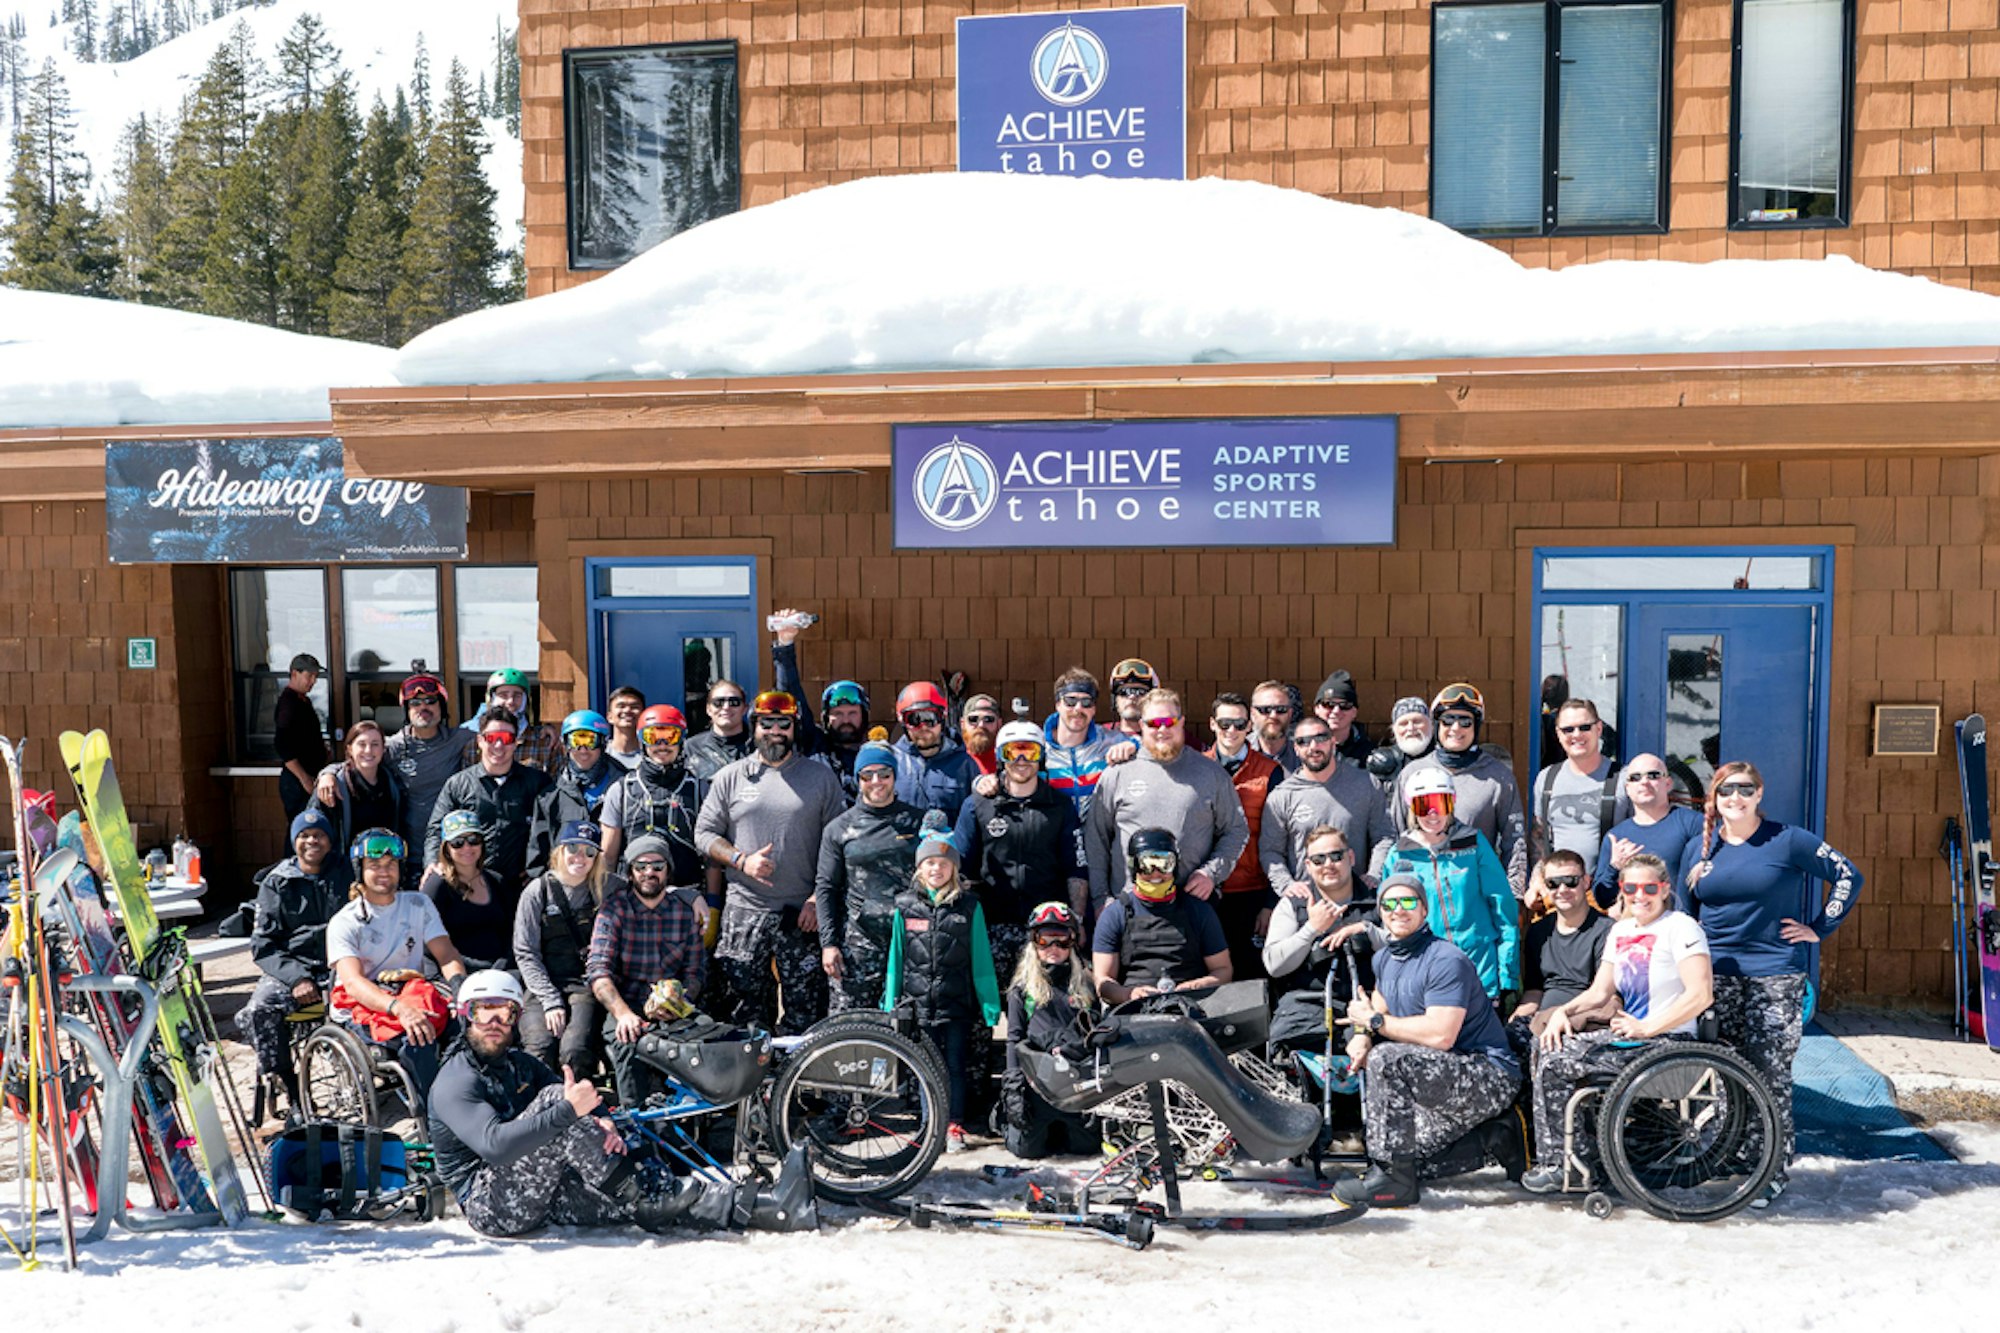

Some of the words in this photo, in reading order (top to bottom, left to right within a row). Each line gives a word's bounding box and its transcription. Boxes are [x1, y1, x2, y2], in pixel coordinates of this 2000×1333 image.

[996, 107, 1145, 143] ACHIEVE
[1000, 143, 1145, 174] tahoe
[1003, 448, 1181, 485] ACHIEVE
[1213, 444, 1350, 465] ADAPTIVE
[149, 468, 331, 525] Hideaway
[1213, 472, 1317, 492] SPORTS
[178, 508, 216, 517] Presented
[218, 507, 228, 521] by
[231, 507, 261, 517] Truckee
[263, 506, 295, 518] Delivery
[1007, 488, 1181, 522] tahoe
[1213, 499, 1321, 520] CENTER
